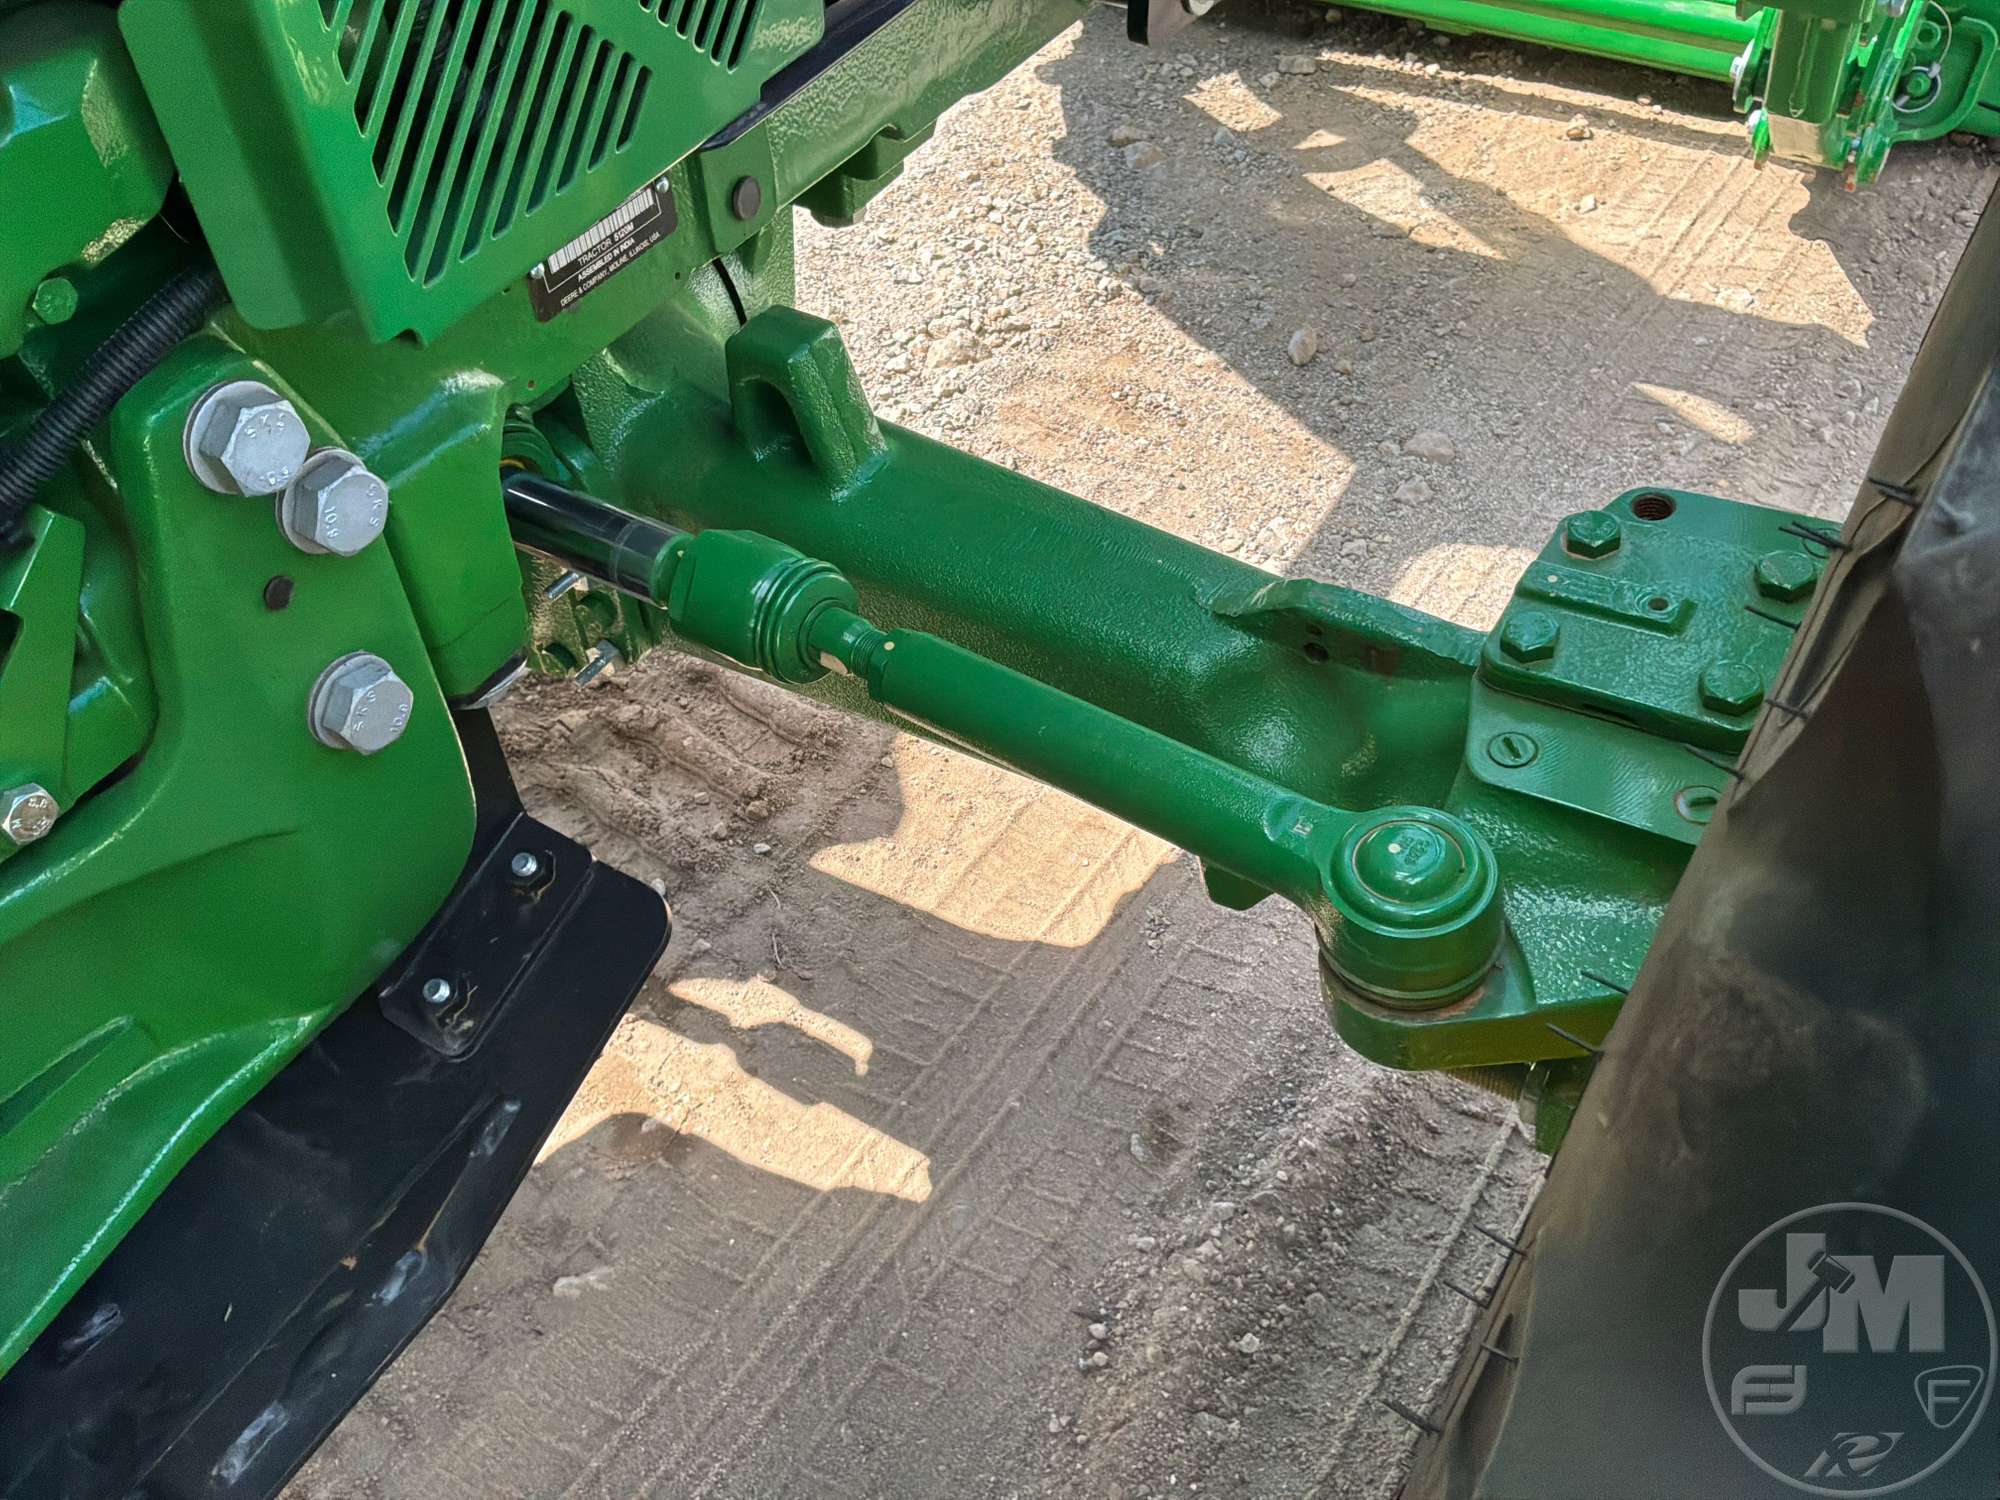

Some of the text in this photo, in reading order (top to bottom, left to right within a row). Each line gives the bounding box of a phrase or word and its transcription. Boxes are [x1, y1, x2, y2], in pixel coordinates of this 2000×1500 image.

[578, 238, 612, 266] TRACTOR
[578, 253, 613, 282] ASSEMBLED
[620, 237, 635, 252] INDIA
[561, 289, 579, 306] DEERE
